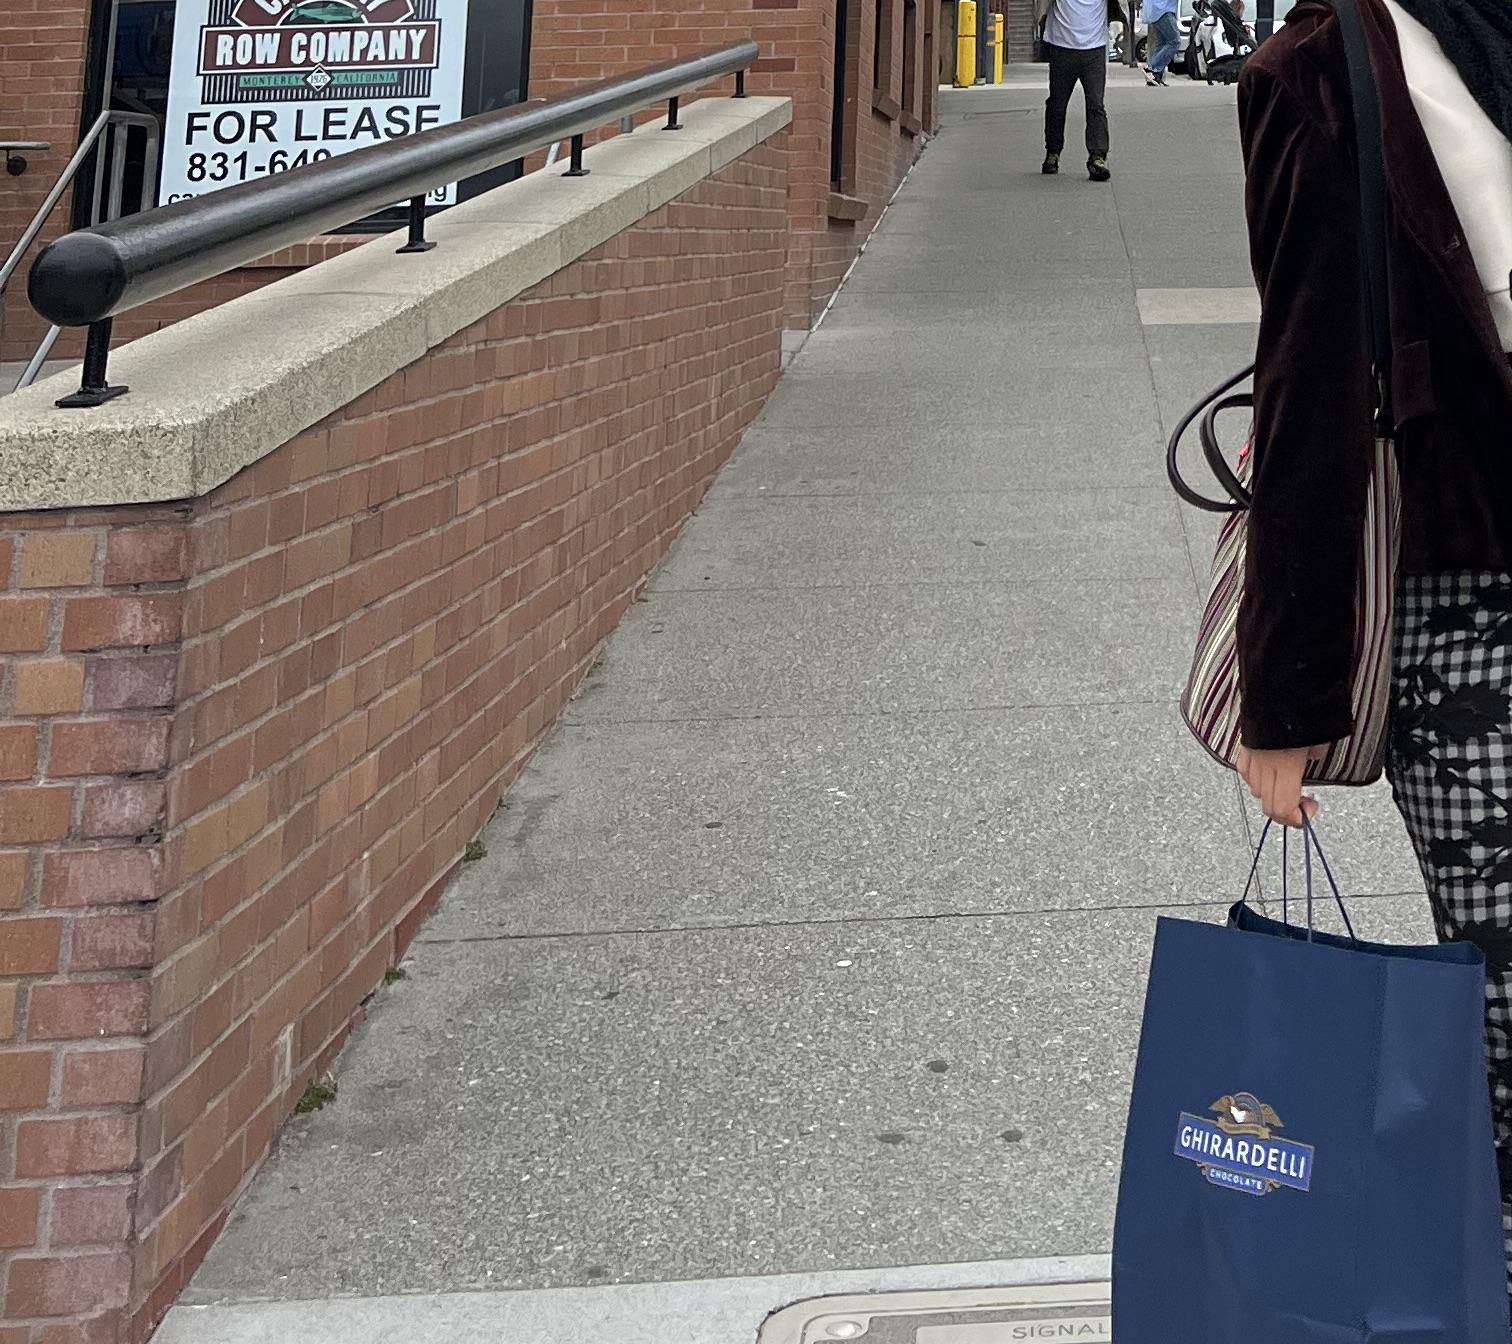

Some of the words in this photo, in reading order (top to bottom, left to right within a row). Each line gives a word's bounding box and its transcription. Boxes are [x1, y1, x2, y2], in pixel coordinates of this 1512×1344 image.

[215, 32, 281, 67] ROW
[290, 28, 428, 65] COMPANY
[242, 75, 301, 87] MONTEREY
[335, 72, 397, 84] CALIFORNIA
[184, 109, 279, 146] FOR
[293, 104, 442, 142] LEASE
[1180, 1125, 1306, 1179] GHIRARDELLI
[1209, 1168, 1263, 1190] CHOCOLATE
[1012, 1322, 1110, 1340] SIGNAL
